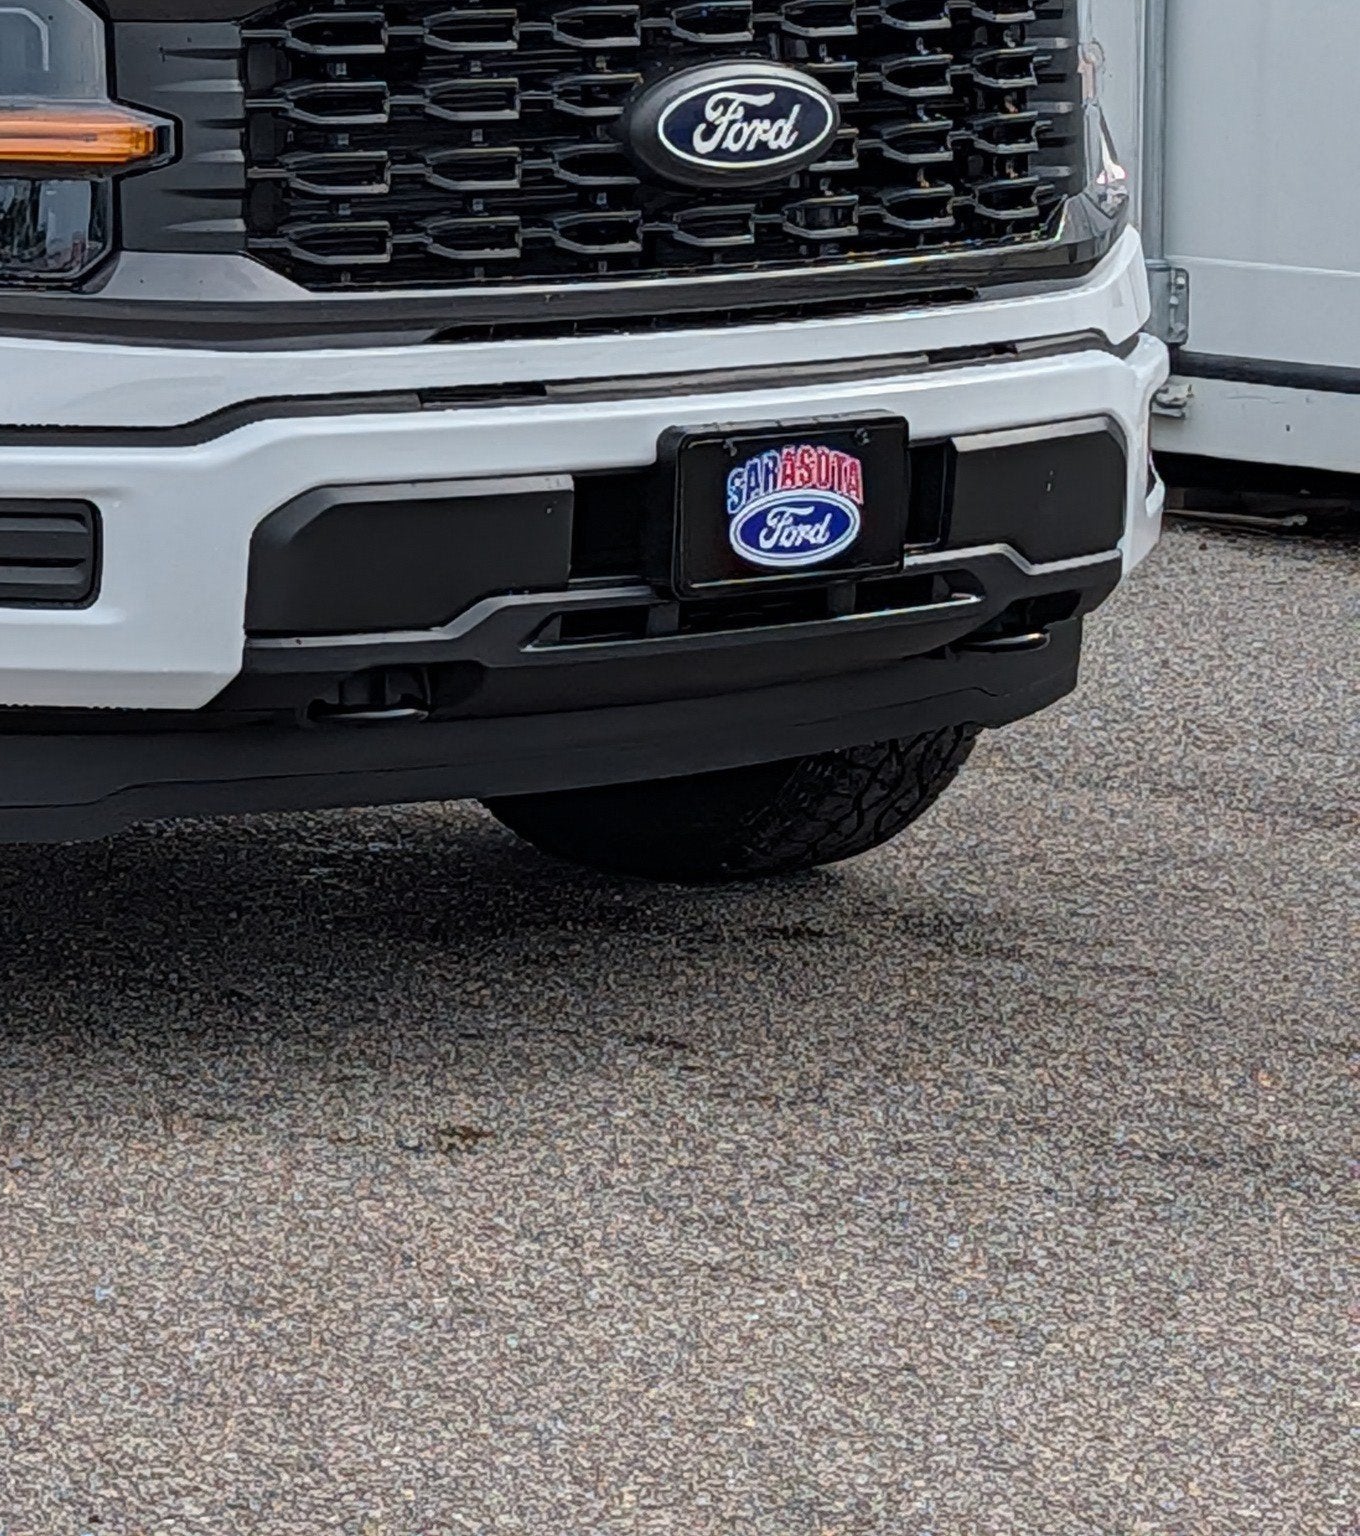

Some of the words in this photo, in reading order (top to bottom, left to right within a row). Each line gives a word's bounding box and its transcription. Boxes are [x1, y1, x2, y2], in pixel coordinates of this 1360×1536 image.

[693, 90, 798, 154] Ford
[727, 444, 864, 514] SARASOTA
[759, 506, 833, 549] Ford
